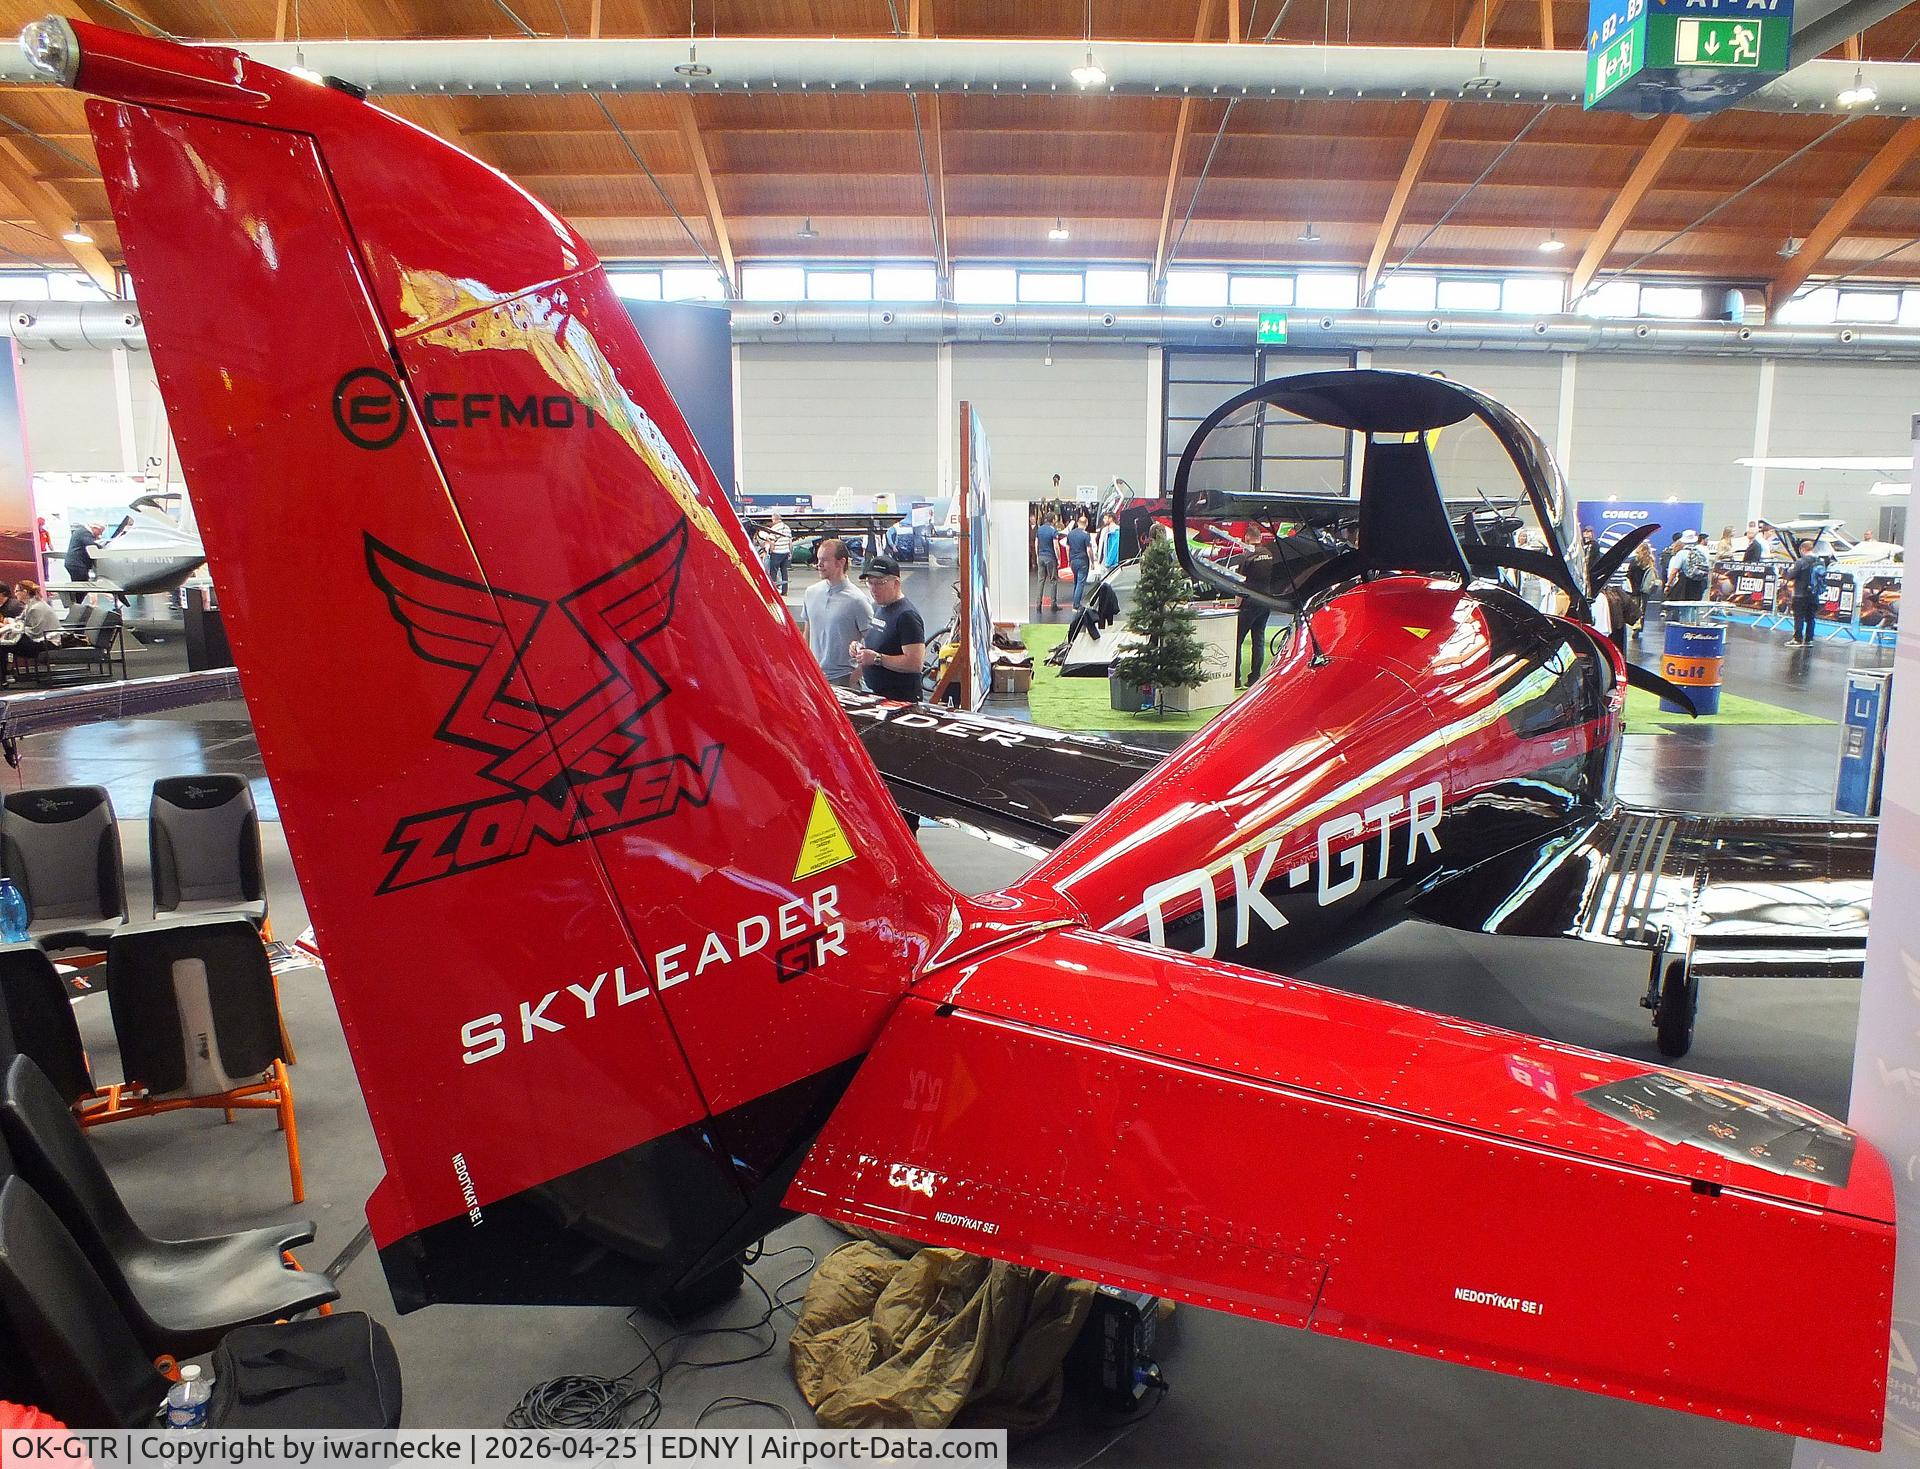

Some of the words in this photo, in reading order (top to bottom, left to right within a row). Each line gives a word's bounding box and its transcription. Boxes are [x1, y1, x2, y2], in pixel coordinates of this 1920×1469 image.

[1602, 12, 1617, 44] B2
[423, 392, 602, 429] CFMOT
[1601, 509, 1649, 520] COMCO
[1665, 662, 1706, 679] Gulf
[846, 706, 1027, 749] ADER
[375, 743, 725, 897] ZONSEN
[1142, 781, 1443, 959] OK-GTR
[460, 884, 842, 1065] SKYLEADER
[1454, 1287, 1521, 1311] NEDOTÝKAT
